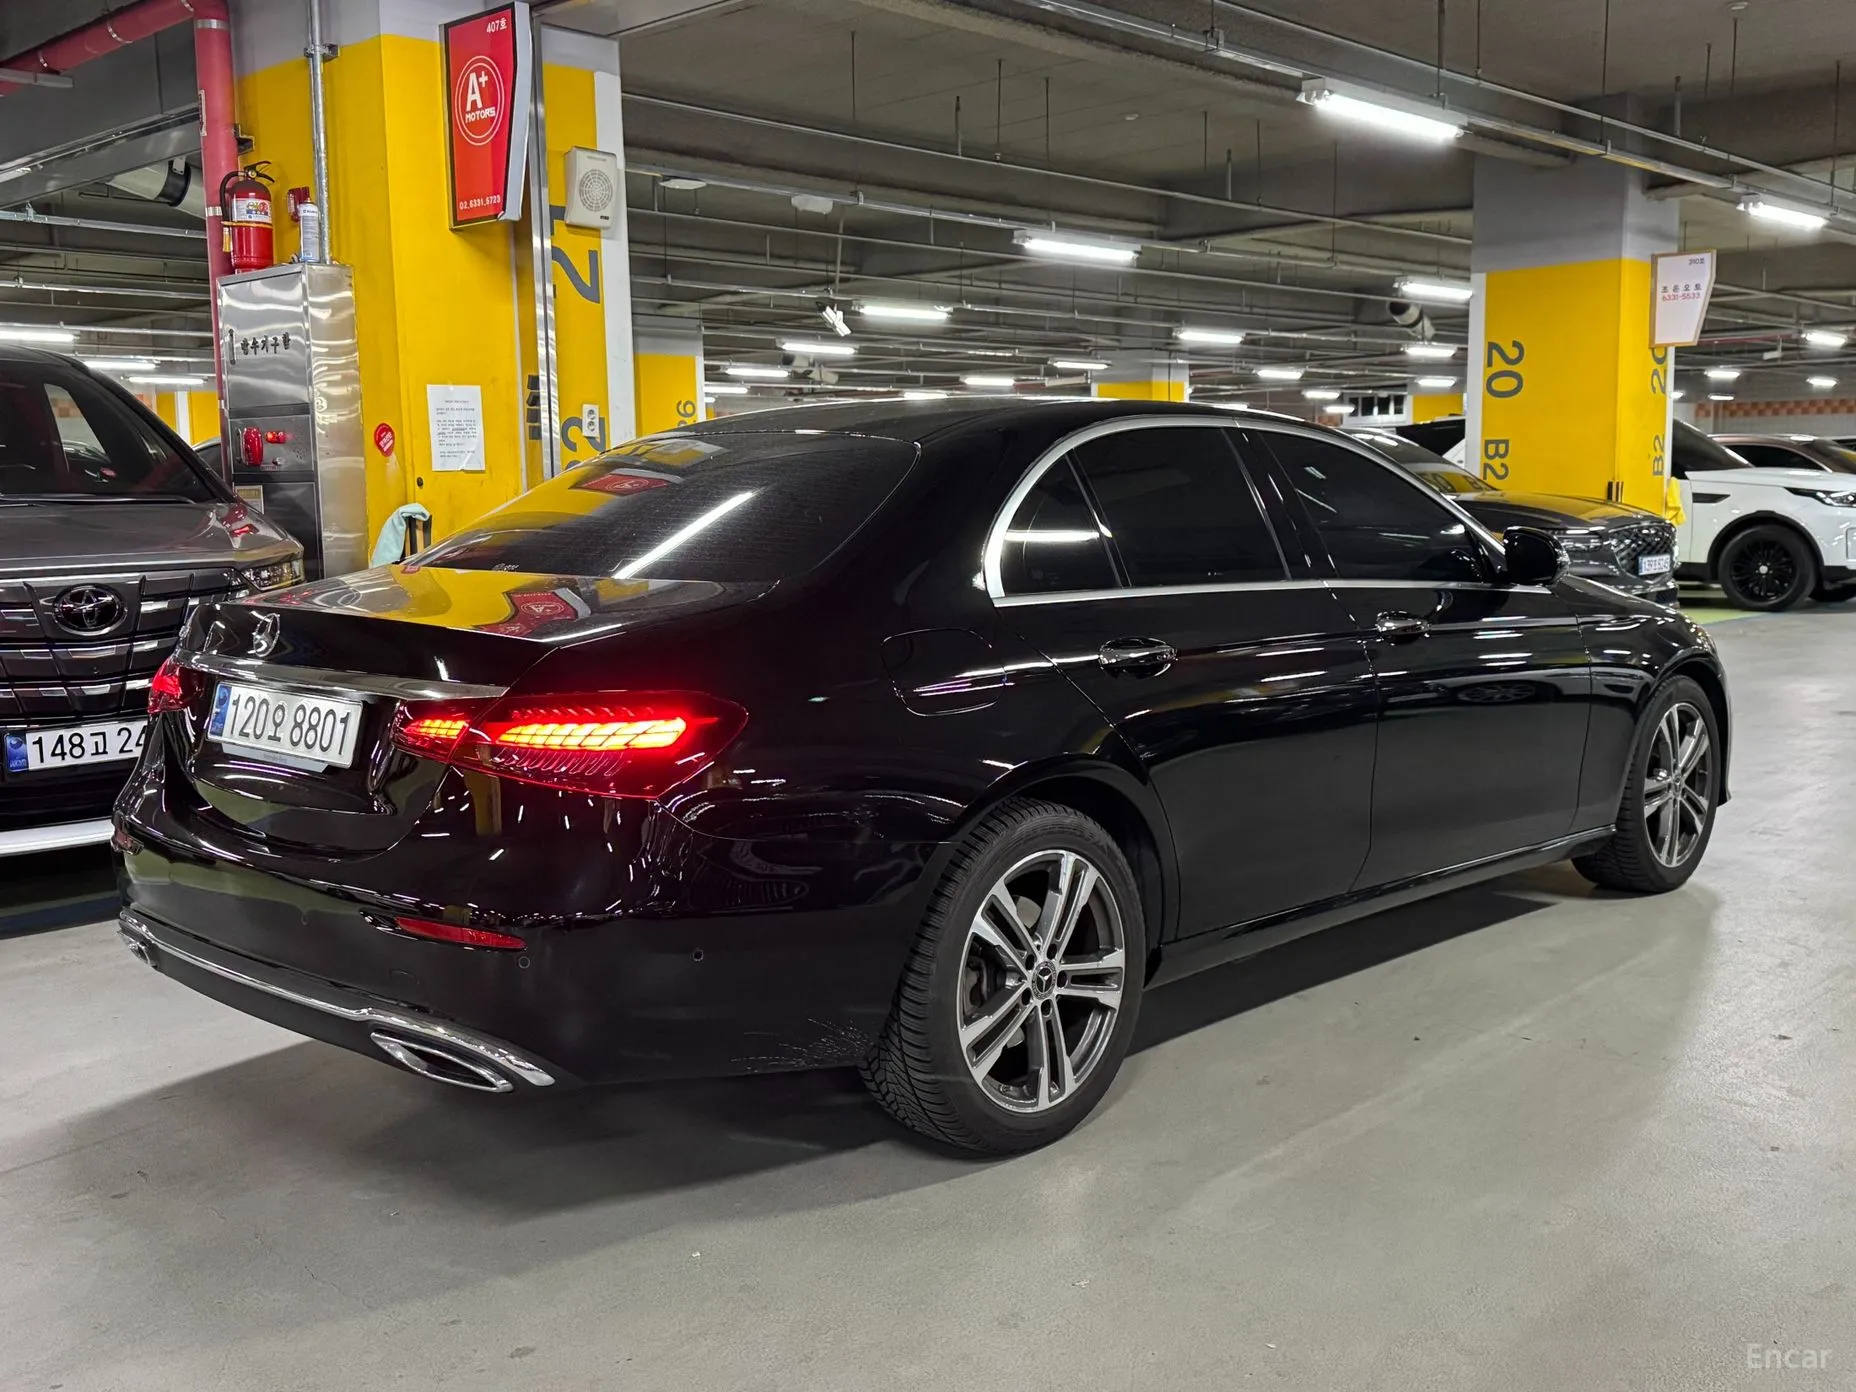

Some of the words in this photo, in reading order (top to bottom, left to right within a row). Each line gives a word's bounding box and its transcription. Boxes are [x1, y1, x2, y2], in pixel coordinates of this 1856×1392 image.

[486, 17, 507, 33] 407호
[466, 70, 488, 112] A+
[465, 106, 496, 123] MOTORS
[1486, 340, 1525, 398] 20
[1483, 439, 1510, 480] B2
[1652, 434, 1666, 476] B2
[230, 693, 286, 743] 120오
[289, 703, 352, 756] 8801
[32, 731, 109, 763] 148고
